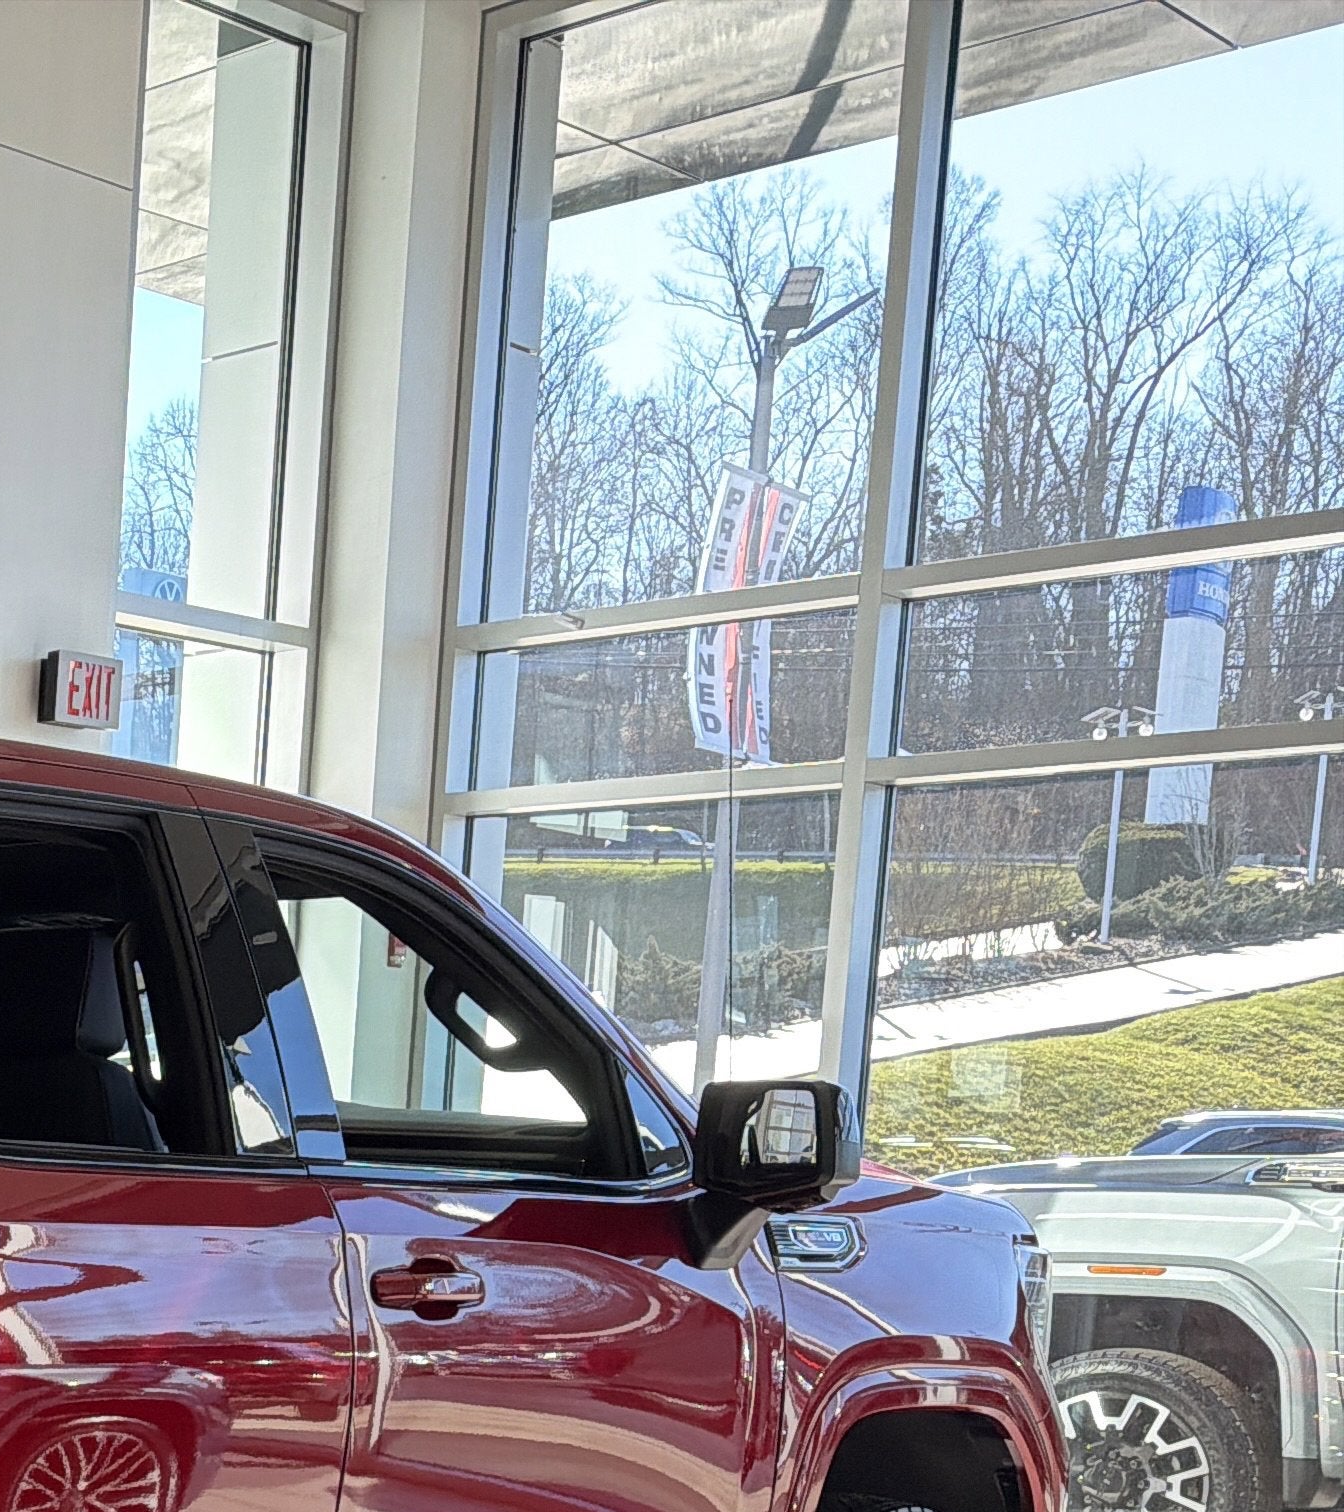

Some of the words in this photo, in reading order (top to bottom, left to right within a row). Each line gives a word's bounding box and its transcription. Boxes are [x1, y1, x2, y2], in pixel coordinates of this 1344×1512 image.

[713, 487, 746, 572] PRE
[67, 660, 116, 721] EXIT
[698, 618, 722, 734] WNED
